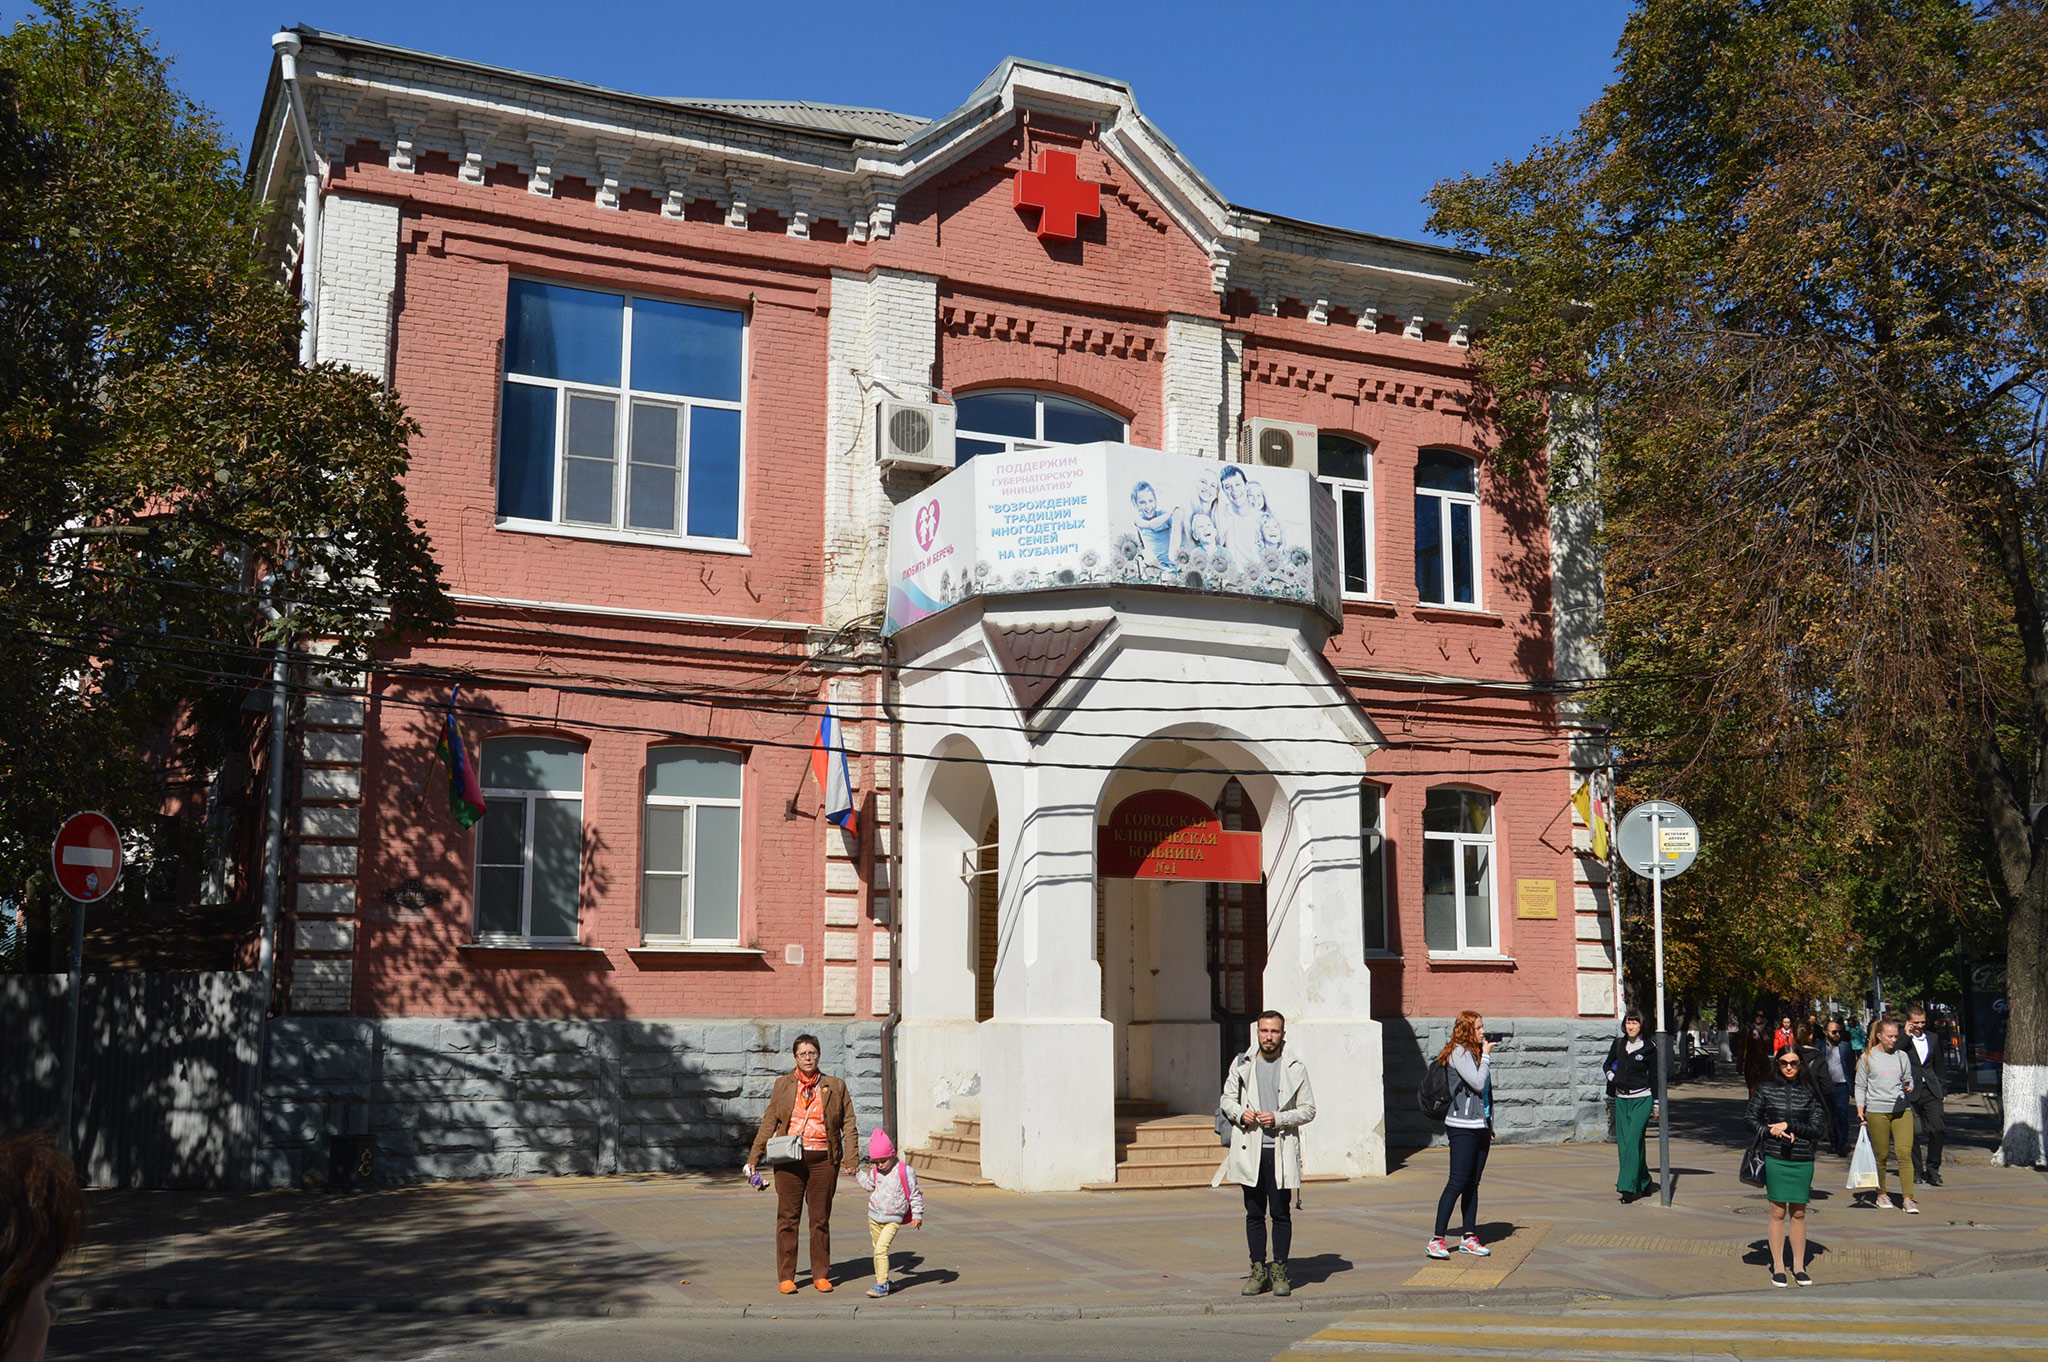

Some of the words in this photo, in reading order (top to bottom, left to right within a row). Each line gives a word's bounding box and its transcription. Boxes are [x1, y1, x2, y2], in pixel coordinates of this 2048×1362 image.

[1296, 430, 1315, 438] SANYO
[996, 457, 1078, 475] ПОДДЕРЖИМ
[991, 469, 1084, 487] ГУБЕРНАТОРСКУЮ
[1001, 481, 1073, 496] ИНИЦИАТИВУ
[1004, 509, 1072, 525] ТРАДИЦИИ
[991, 519, 1086, 537] МНОГОДЕТНЫХ
[1017, 531, 1059, 547] СЕМЕЙ
[901, 560, 926, 582] ЛЮБИТЬ
[926, 555, 932, 568] И
[932, 544, 955, 564] БЕРЕЧЬ
[998, 550, 1016, 560] НА
[1125, 813, 1207, 828] ГОРОДСКАЯ
[1114, 829, 1217, 845] КЛИНИЧЕСКАЯ
[1129, 846, 1204, 861] БОЛЬНИЦА
[1155, 862, 1177, 874] №1
